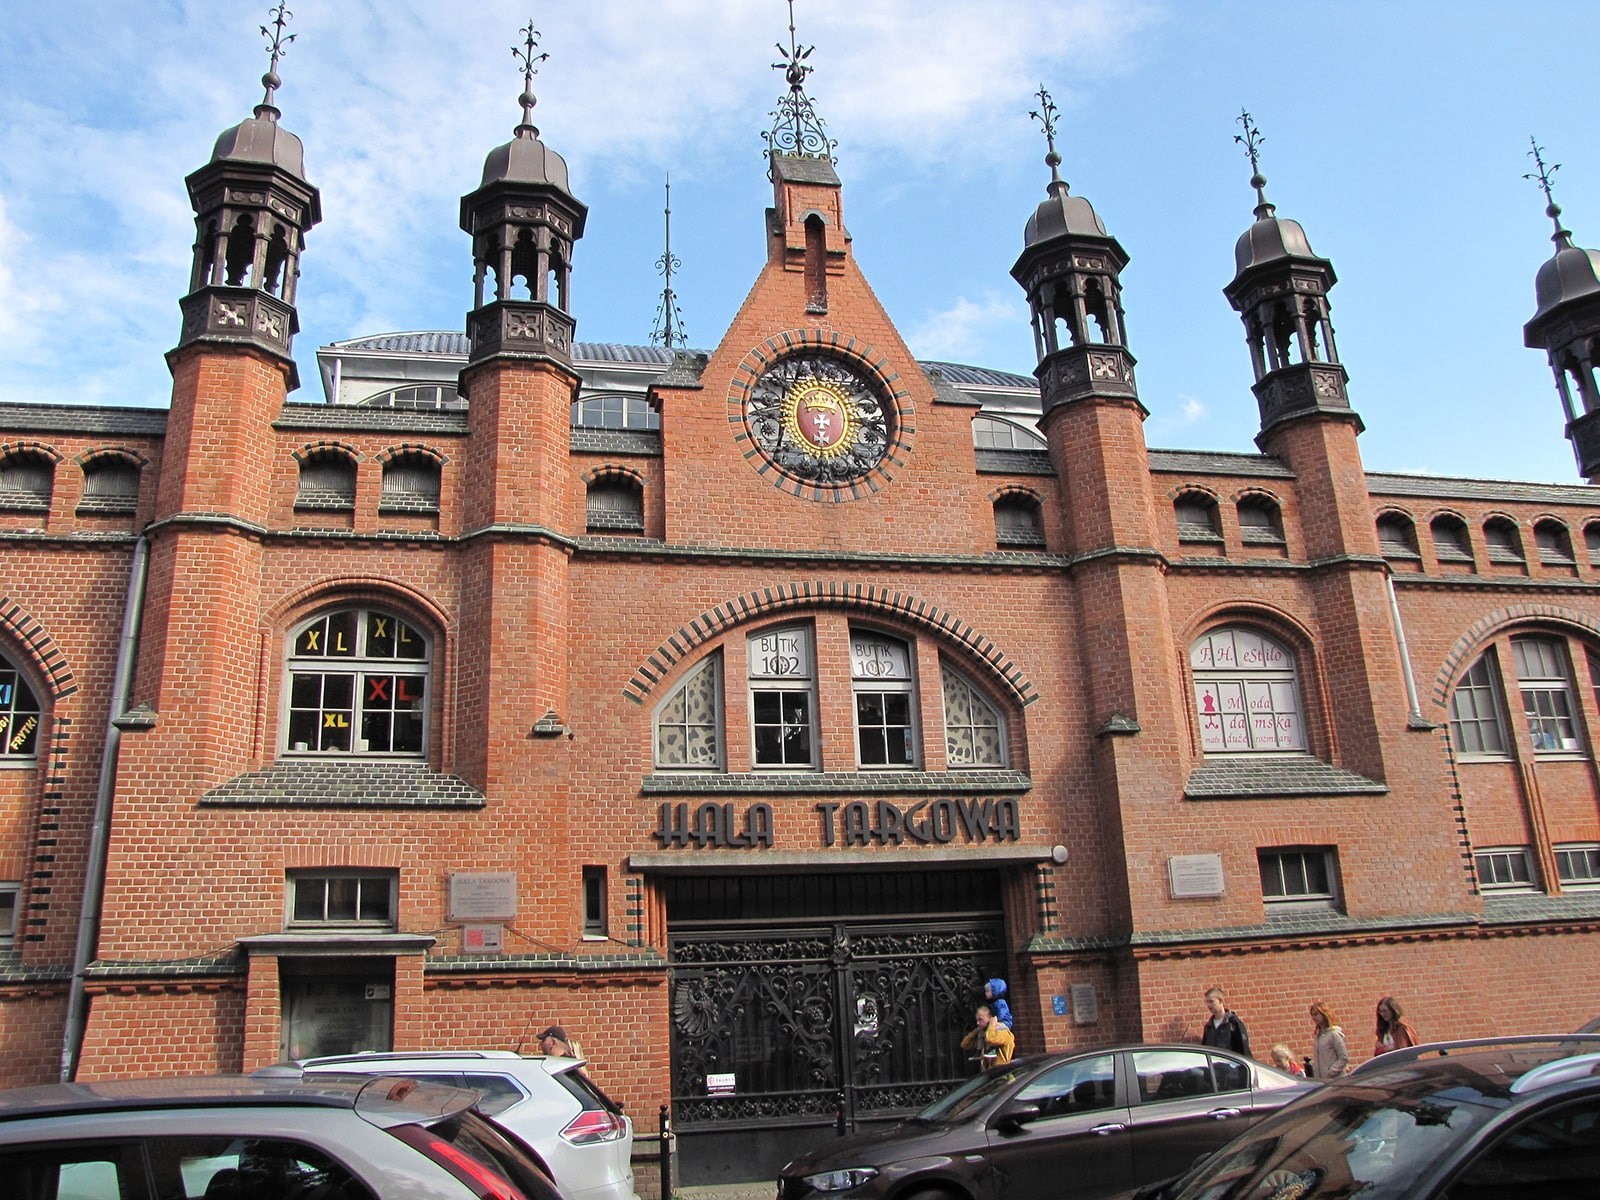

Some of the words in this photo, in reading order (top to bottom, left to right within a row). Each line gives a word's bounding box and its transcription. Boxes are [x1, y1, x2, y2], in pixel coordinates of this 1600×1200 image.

[1227, 696, 1271, 709] Moda
[323, 713, 349, 728] XL
[1229, 715, 1291, 731] damska
[653, 801, 774, 848] HALA
[817, 798, 1021, 848] TARGOWA
